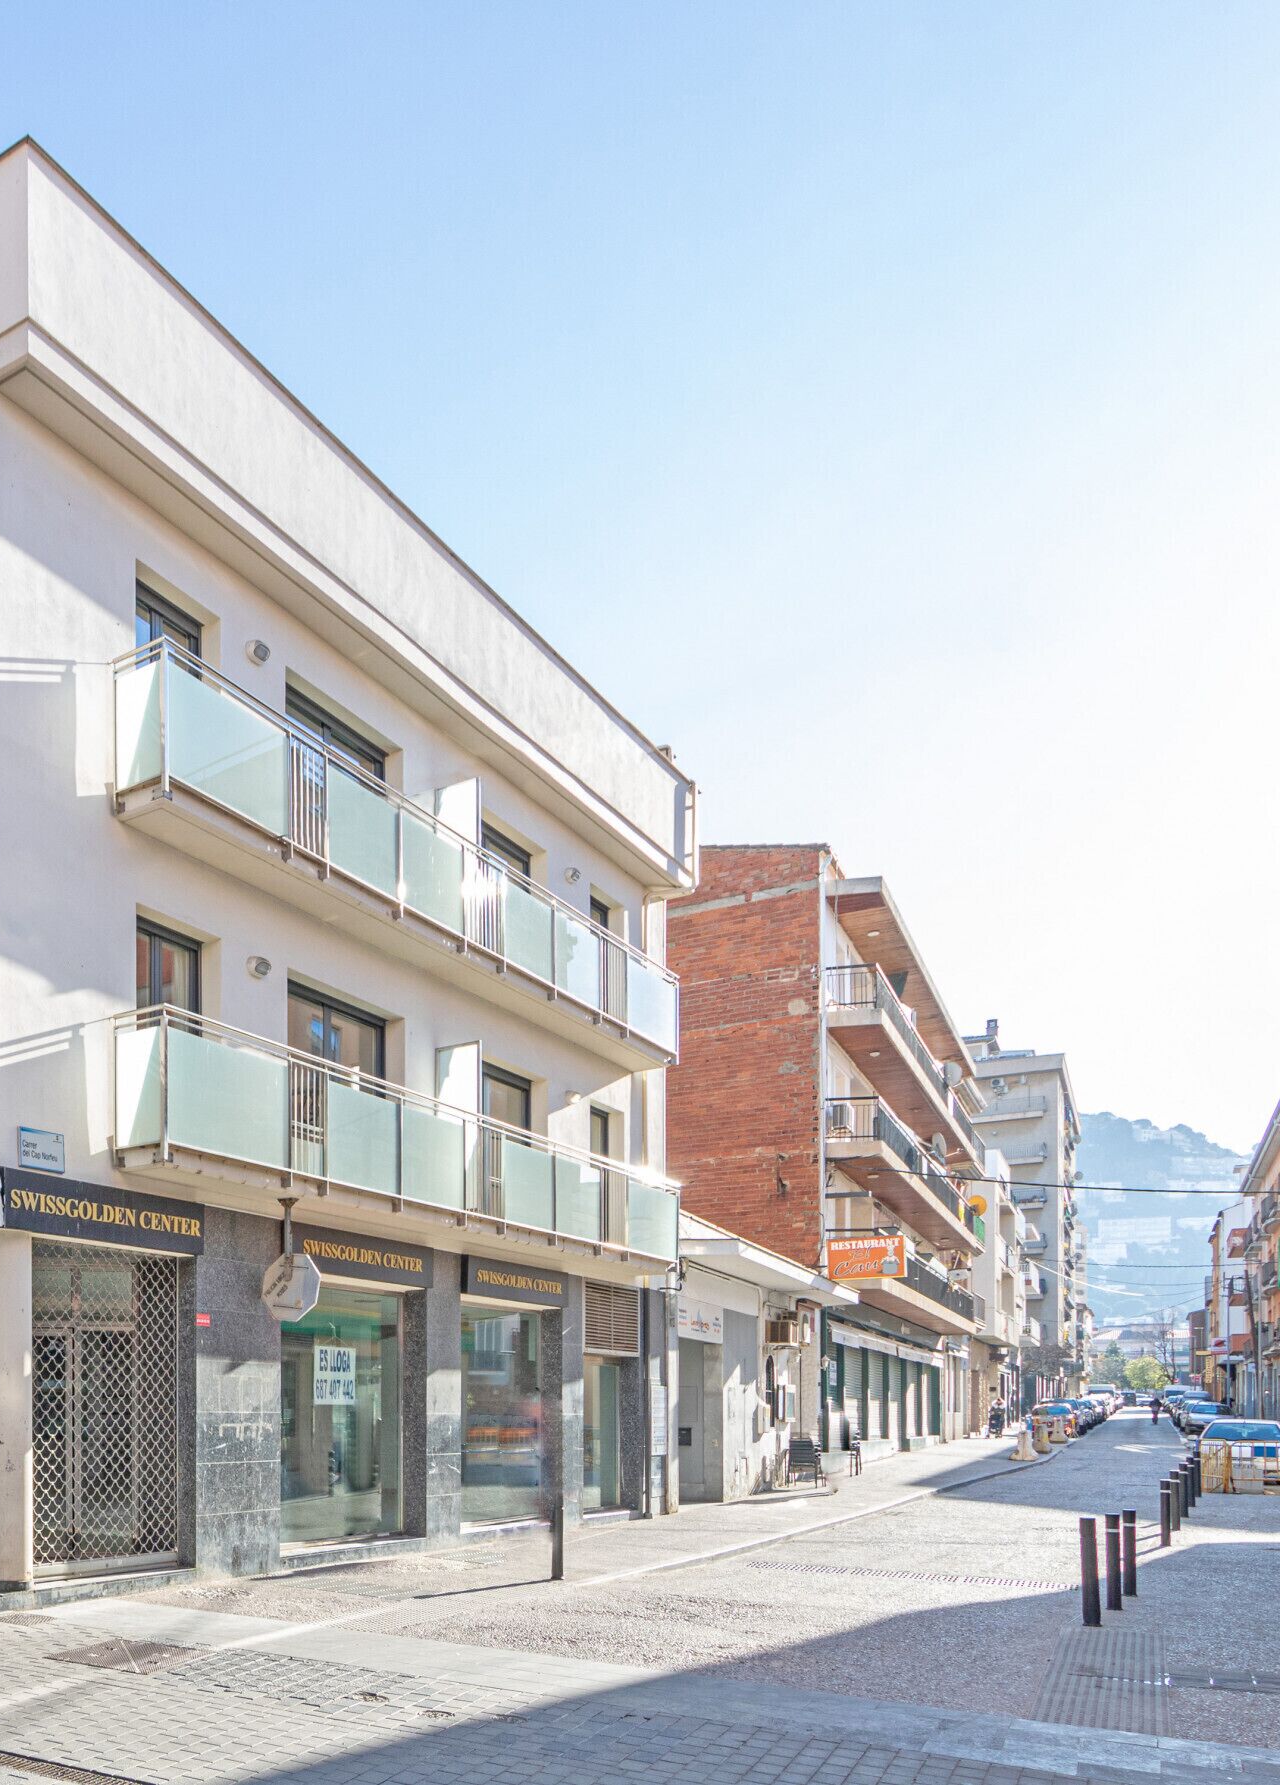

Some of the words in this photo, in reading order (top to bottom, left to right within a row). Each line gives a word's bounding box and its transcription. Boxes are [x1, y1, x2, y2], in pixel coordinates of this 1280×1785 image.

[22, 1139, 38, 1150] Carrer
[31, 1150, 41, 1161] Cap
[10, 1189, 136, 1228] SWISSGOLDEN
[139, 1210, 201, 1237] CENTER
[830, 1237, 900, 1251] RESTAURANT
[303, 1239, 382, 1265] SWISSGOLDEN
[383, 1252, 423, 1273] CENTER
[477, 1269, 534, 1290] SWISSGOLDEN
[534, 1279, 562, 1295] CENTER
[319, 1349, 329, 1372] ES
[330, 1350, 351, 1373] LLOGA
[316, 1378, 328, 1400] 687
[329, 1378, 341, 1400] 407
[342, 1379, 354, 1400] 442
